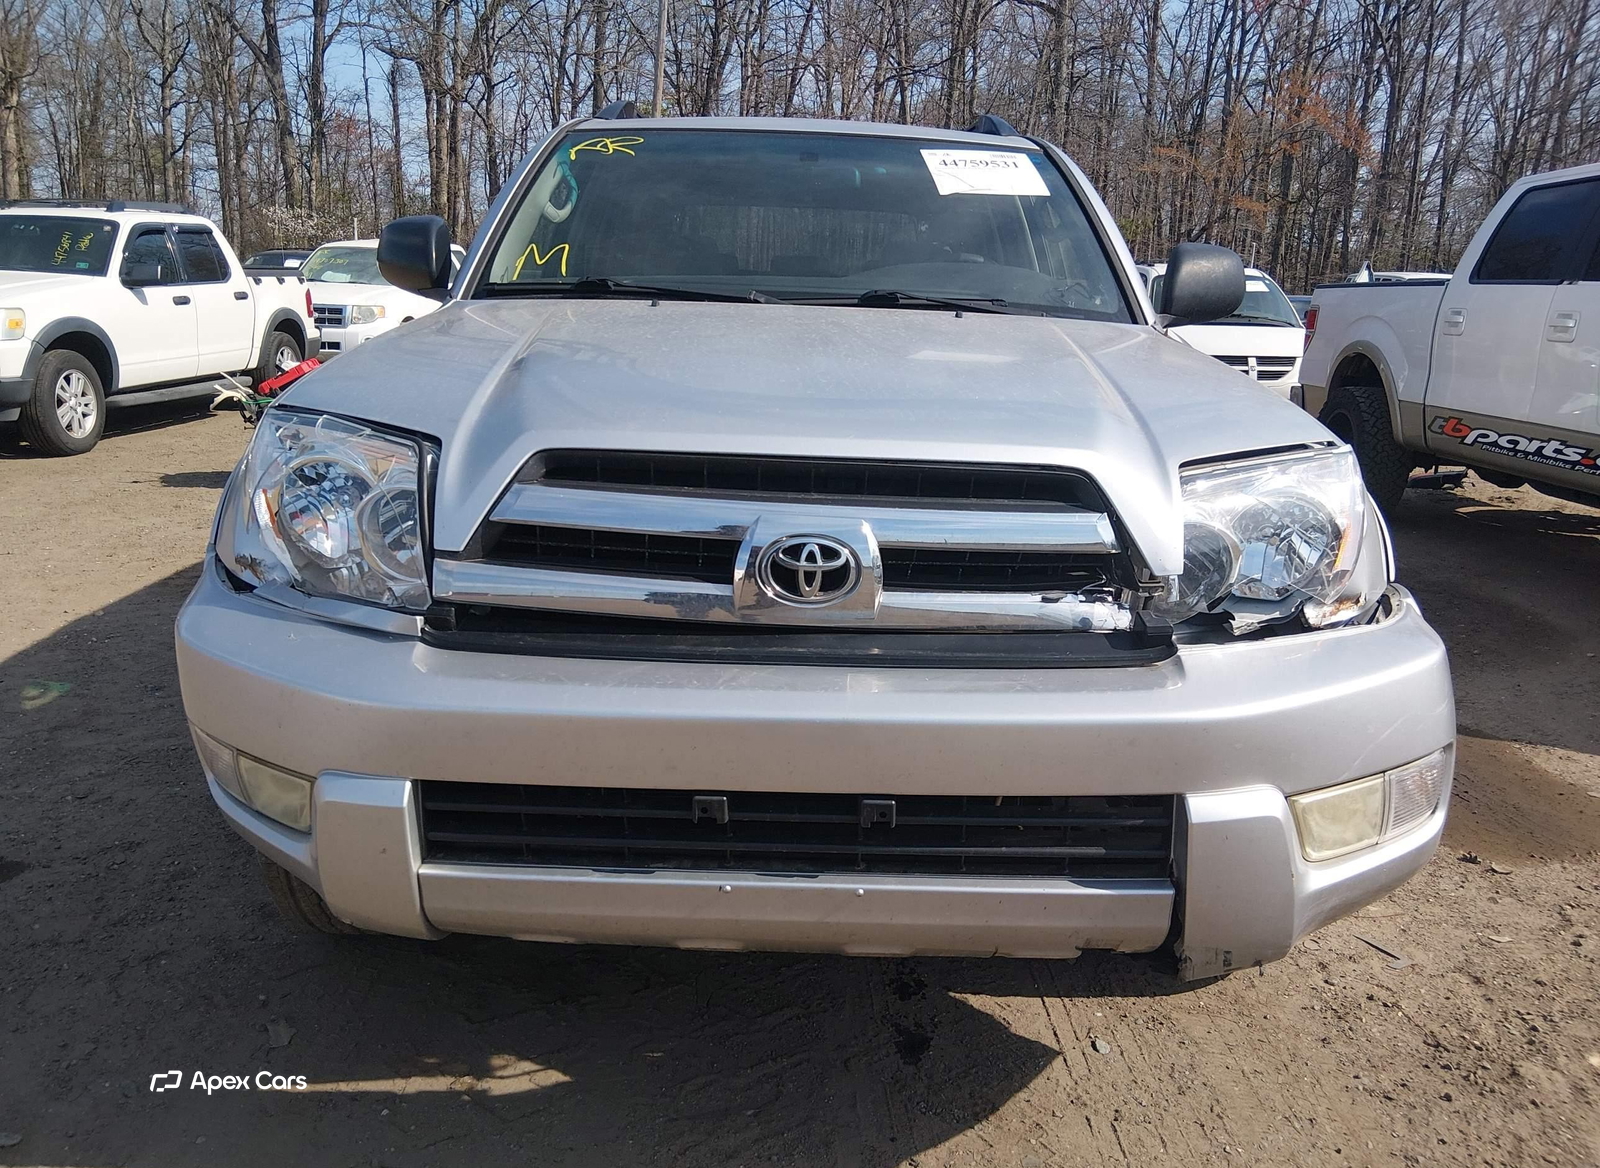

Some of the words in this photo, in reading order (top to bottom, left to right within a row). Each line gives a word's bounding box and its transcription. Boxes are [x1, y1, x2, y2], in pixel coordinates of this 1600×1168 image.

[938, 158, 1020, 169] 44759531
[511, 242, 570, 281] M
[1429, 416, 1600, 466] tbparts.
[1481, 444, 1514, 457] Pitbike
[1526, 454, 1573, 470] Minibike
